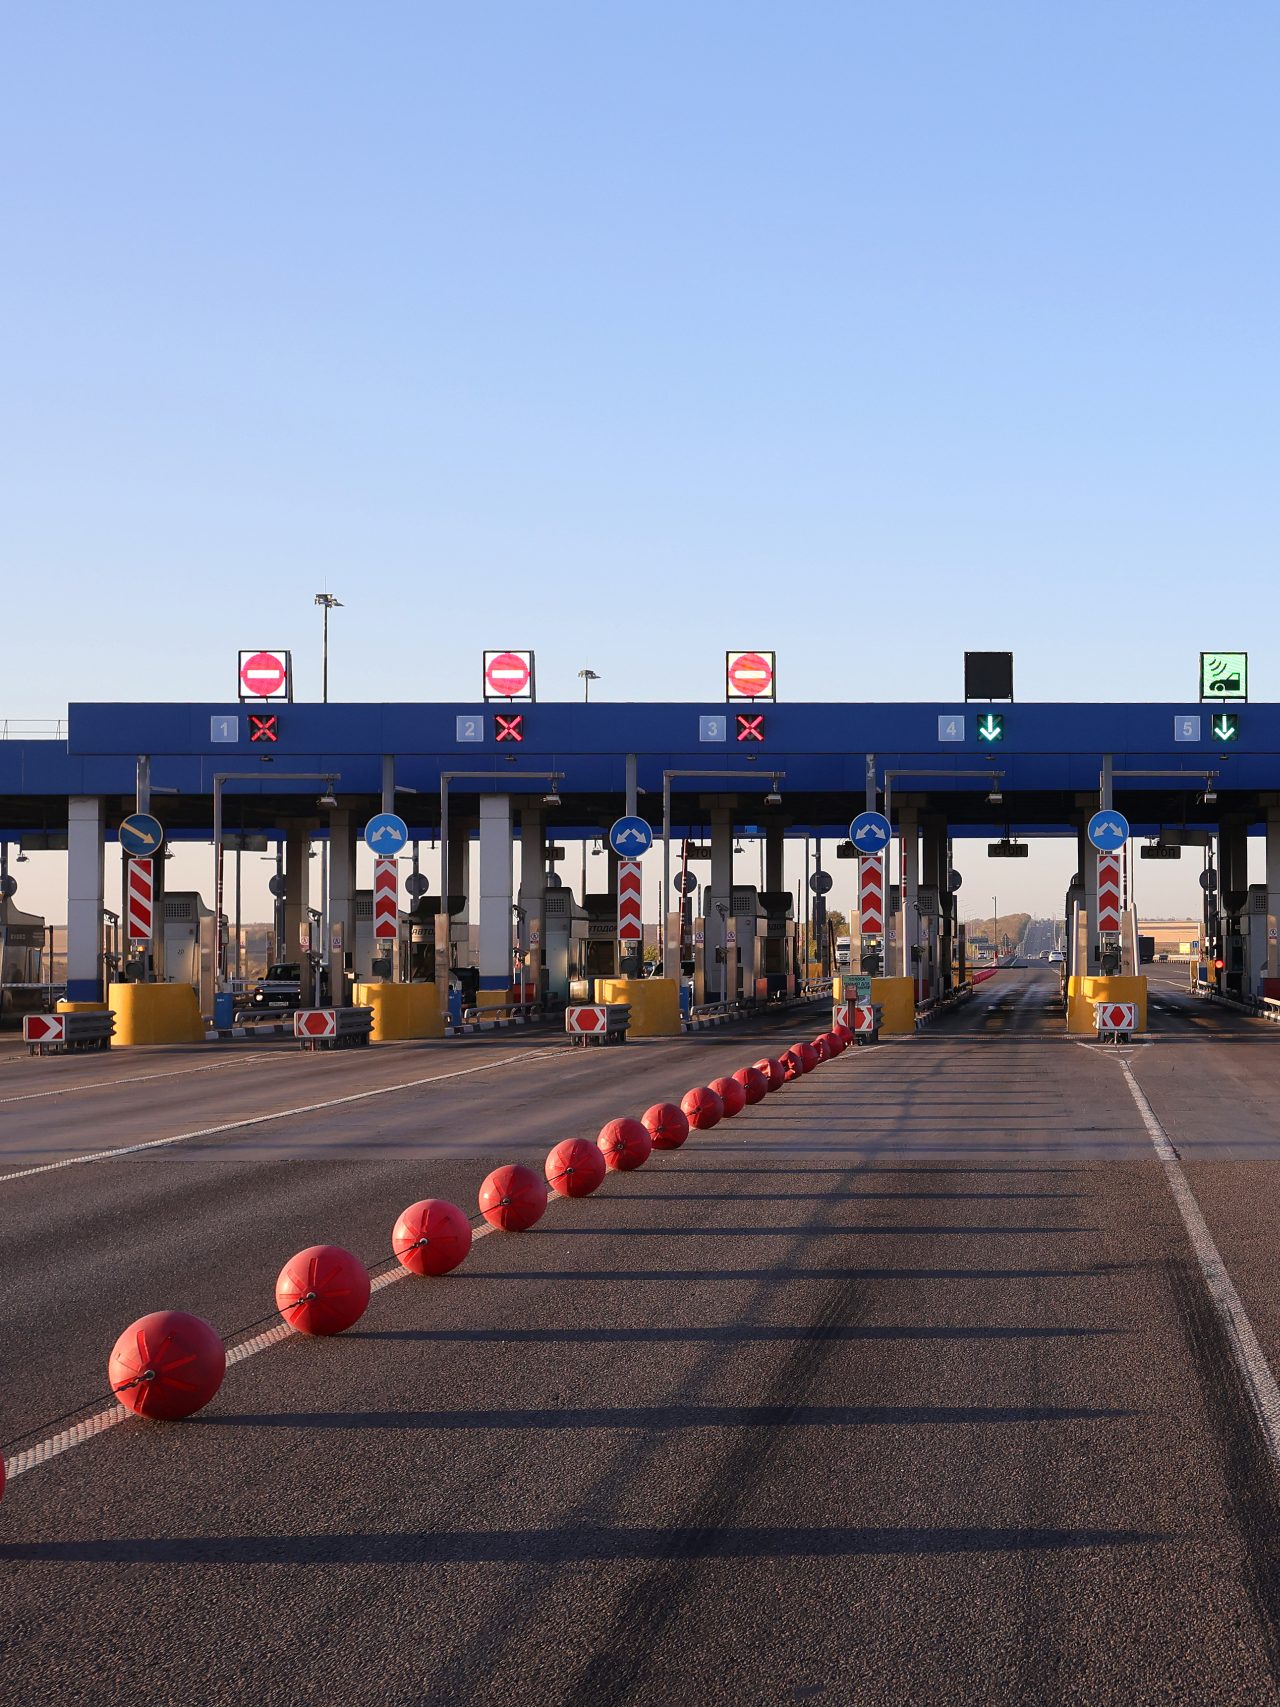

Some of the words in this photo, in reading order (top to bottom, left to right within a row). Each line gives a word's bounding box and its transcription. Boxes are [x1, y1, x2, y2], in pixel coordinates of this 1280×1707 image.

[220, 722, 228, 737] 1
[464, 721, 475, 737] 2
[707, 721, 718, 737] 3
[946, 721, 957, 736] 4
[1183, 721, 1193, 736] 5
[688, 848, 711, 857] СТО
[994, 846, 1023, 855] СТОП
[1148, 848, 1175, 857] СТОП
